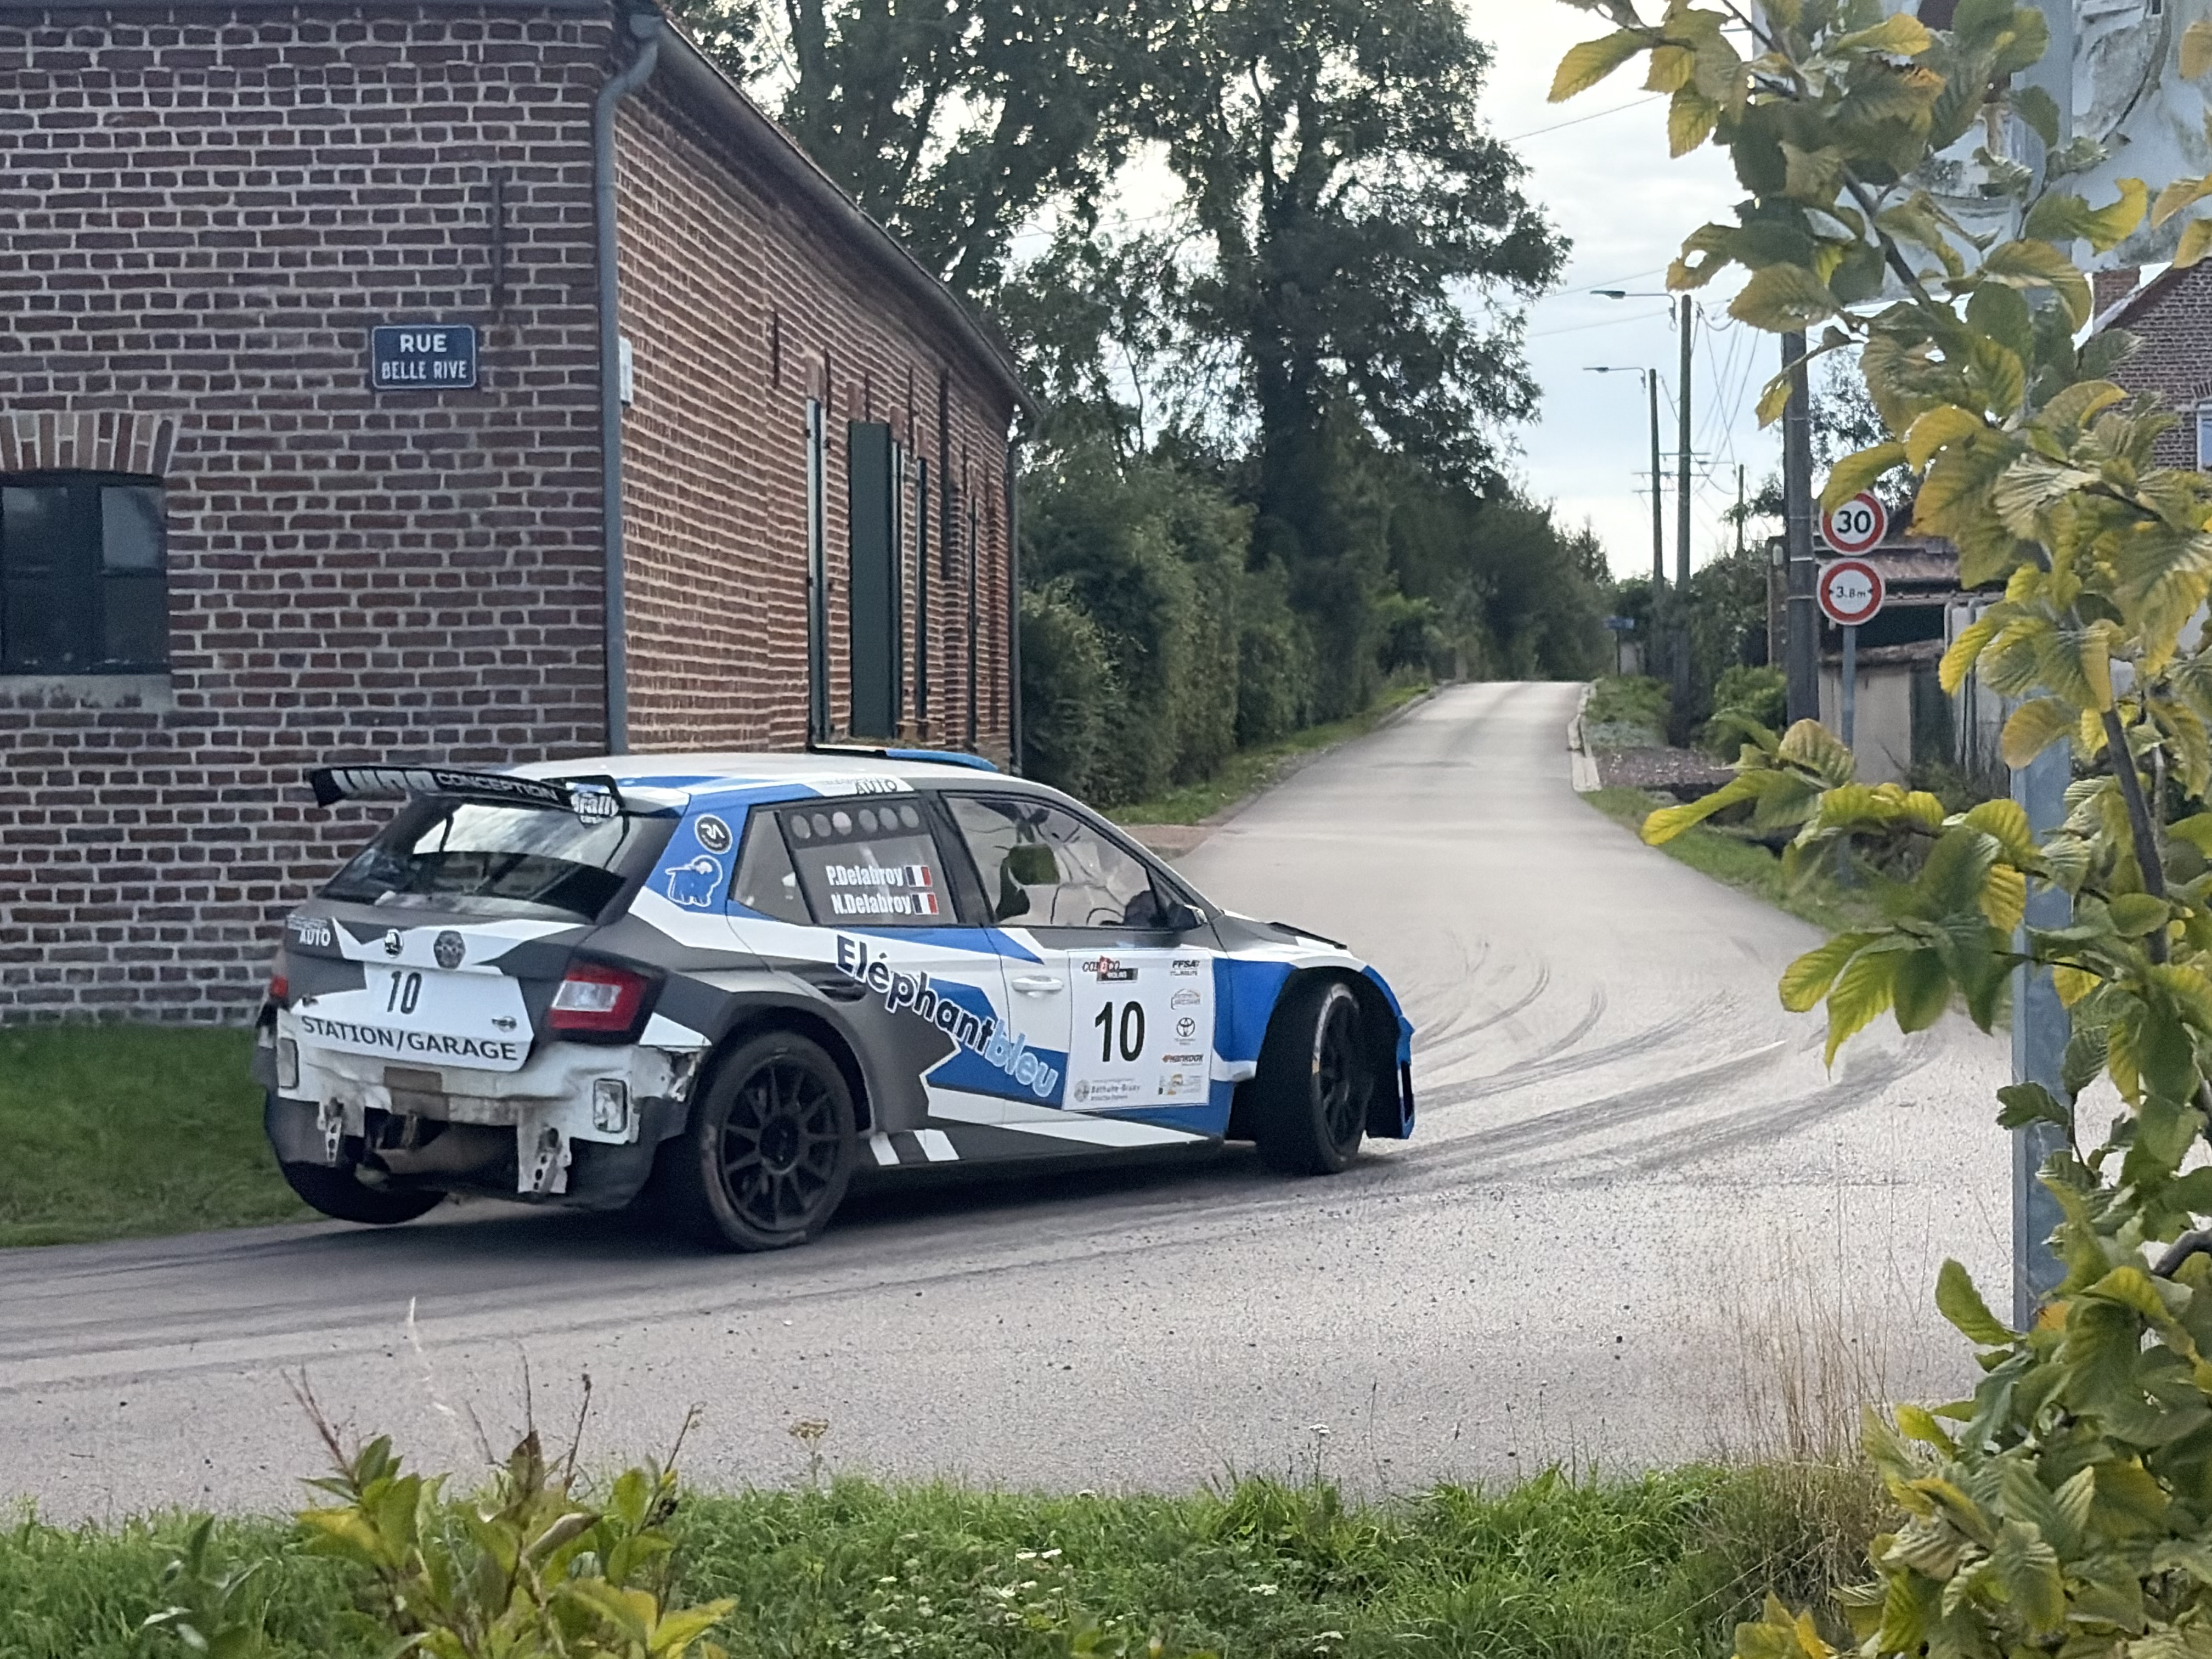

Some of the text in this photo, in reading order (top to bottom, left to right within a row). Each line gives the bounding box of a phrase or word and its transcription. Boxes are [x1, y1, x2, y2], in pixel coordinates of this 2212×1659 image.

[400, 334, 447, 353] RUE
[381, 360, 467, 380] BELLE RIVE
[1836, 510, 1871, 534] 30
[1836, 585, 1866, 598] 3.8m
[436, 771, 559, 802] CONCEPTION
[825, 865, 904, 887] P.Delabroy
[298, 927, 331, 947] AUTO
[386, 970, 422, 1015] 10
[1094, 1000, 1145, 1063] 10
